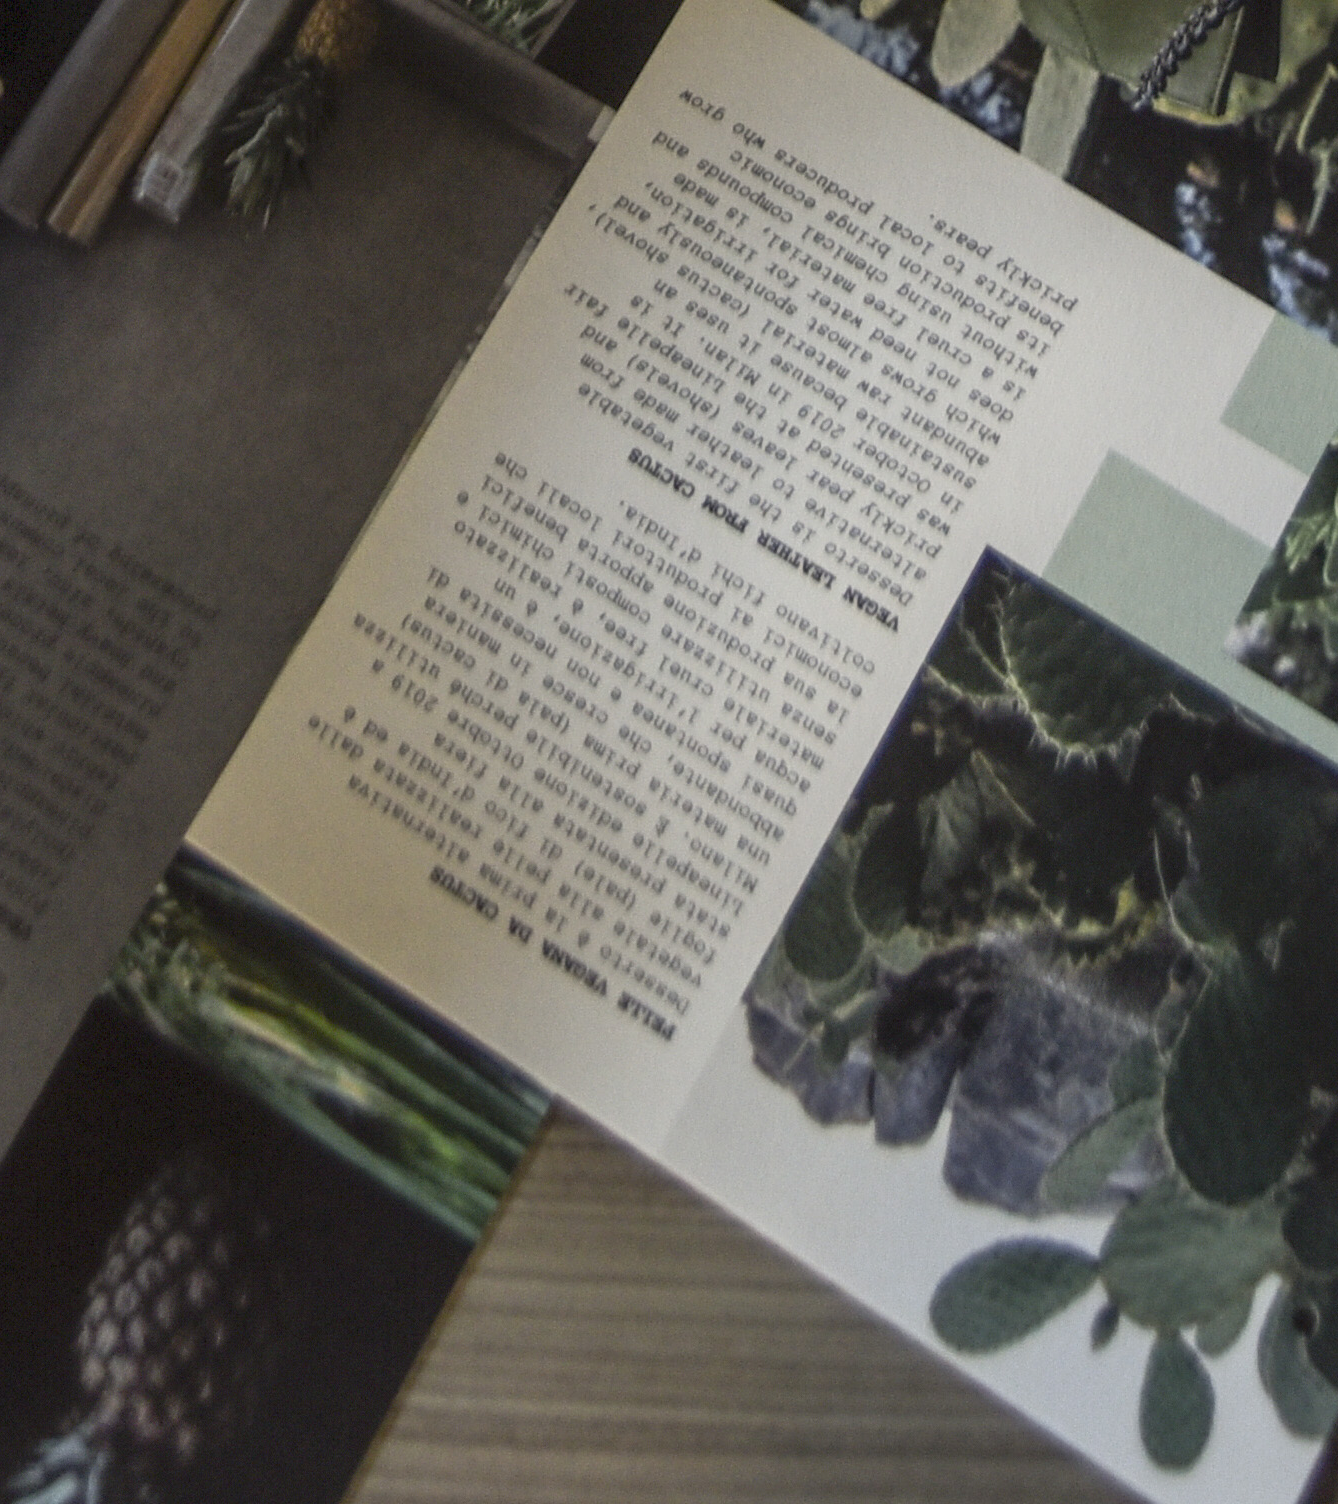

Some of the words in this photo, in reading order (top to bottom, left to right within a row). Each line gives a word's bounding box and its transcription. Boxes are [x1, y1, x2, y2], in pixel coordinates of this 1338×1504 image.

[629, 295, 654, 317] is
[662, 314, 686, 339] It
[579, 353, 626, 391] from
[699, 336, 762, 388] Milan.
[633, 388, 681, 424] made
[767, 382, 792, 406] in
[577, 383, 674, 453] vegetable
[797, 404, 846, 440] 2019
[627, 447, 696, 499] CACTUS
[684, 451, 741, 496] first
[685, 423, 764, 481] leather
[852, 437, 932, 494] October
[748, 493, 783, 524] the
[771, 477, 796, 501] to
[940, 491, 965, 515] in
[701, 494, 750, 535] FROM
[791, 520, 817, 545] is
[756, 529, 836, 590] LEATHER
[804, 498, 927, 582] alternative
[823, 542, 914, 608] Desserto
[842, 585, 899, 633] VEGAN
[433, 732, 489, 781] fiera
[498, 775, 545, 814] alla
[552, 812, 668, 896] presentata
[429, 865, 499, 922] CACTUS
[673, 892, 731, 939] stata
[508, 916, 533, 945] DA
[541, 938, 608, 997] VEGANA
[617, 991, 676, 1042] PELLE
